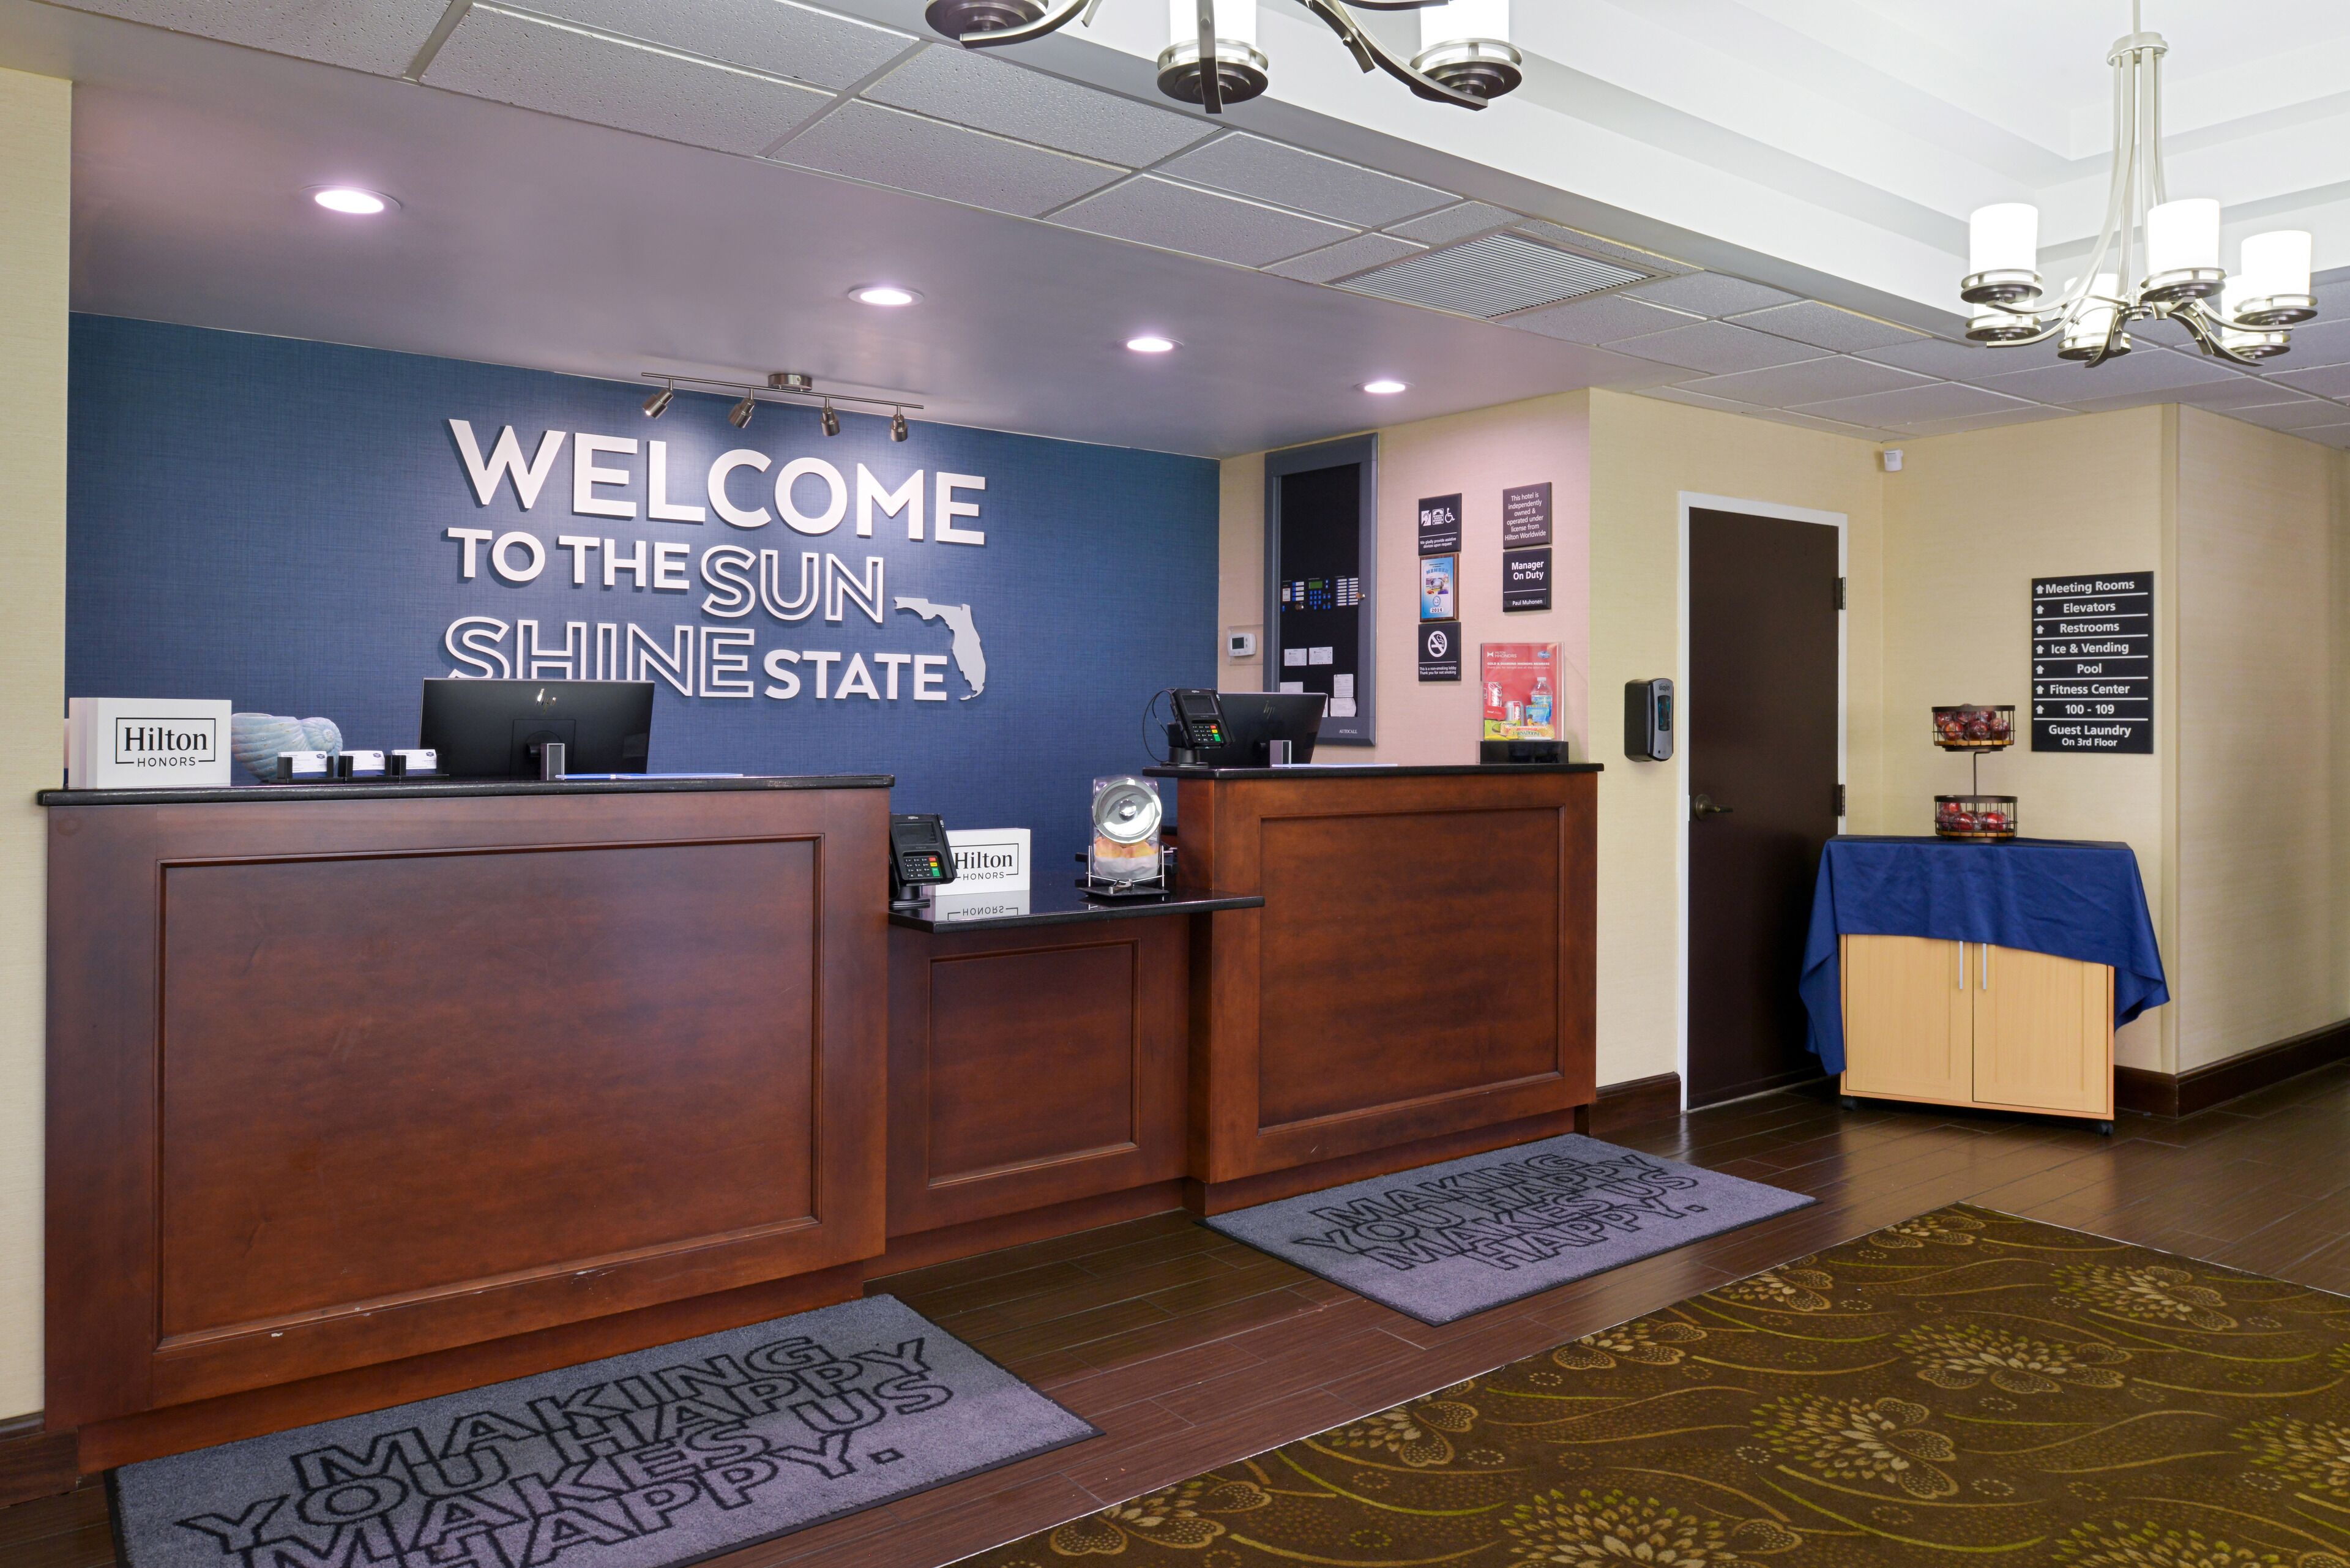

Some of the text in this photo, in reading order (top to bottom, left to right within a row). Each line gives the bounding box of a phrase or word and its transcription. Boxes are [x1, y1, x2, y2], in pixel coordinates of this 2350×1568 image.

[449, 418, 986, 545] WELCOME
[1508, 499, 1542, 509] independently
[1507, 517, 1528, 526] operated
[1520, 530, 1546, 539] Worldwide
[1512, 561, 1544, 570] Manager
[447, 527, 884, 624] TO THE SUN
[1513, 571, 1544, 580] On Duty
[2045, 581, 2135, 594] Meeting Rooms
[2063, 602, 2116, 613] Elevators
[2060, 622, 2120, 633] Restrooms
[2051, 642, 2129, 654] Ice & Vending
[445, 616, 947, 701] SHINE STATE
[2076, 663, 2102, 673] Pool
[2050, 684, 2130, 694] Fitness Center
[2065, 704, 2084, 714] 100
[2095, 704, 2115, 714] 109
[2049, 725, 2132, 737] Guest Laundry
[124, 727, 207, 751] Hilton
[138, 756, 196, 767] HONORS
[955, 852, 1013, 869] Hilton
[963, 872, 1004, 880] HONORS
[1308, 1154, 1591, 1228] MAKING
[1290, 1154, 1669, 1255] YOU HAPPY
[1360, 1170, 1699, 1271] MAKES US
[1459, 1197, 1708, 1271] HAPPY.
[290, 1335, 837, 1492] MAKING
[174, 1336, 933, 1555] YOU HAPPY
[240, 1373, 953, 1568] MAKES US
